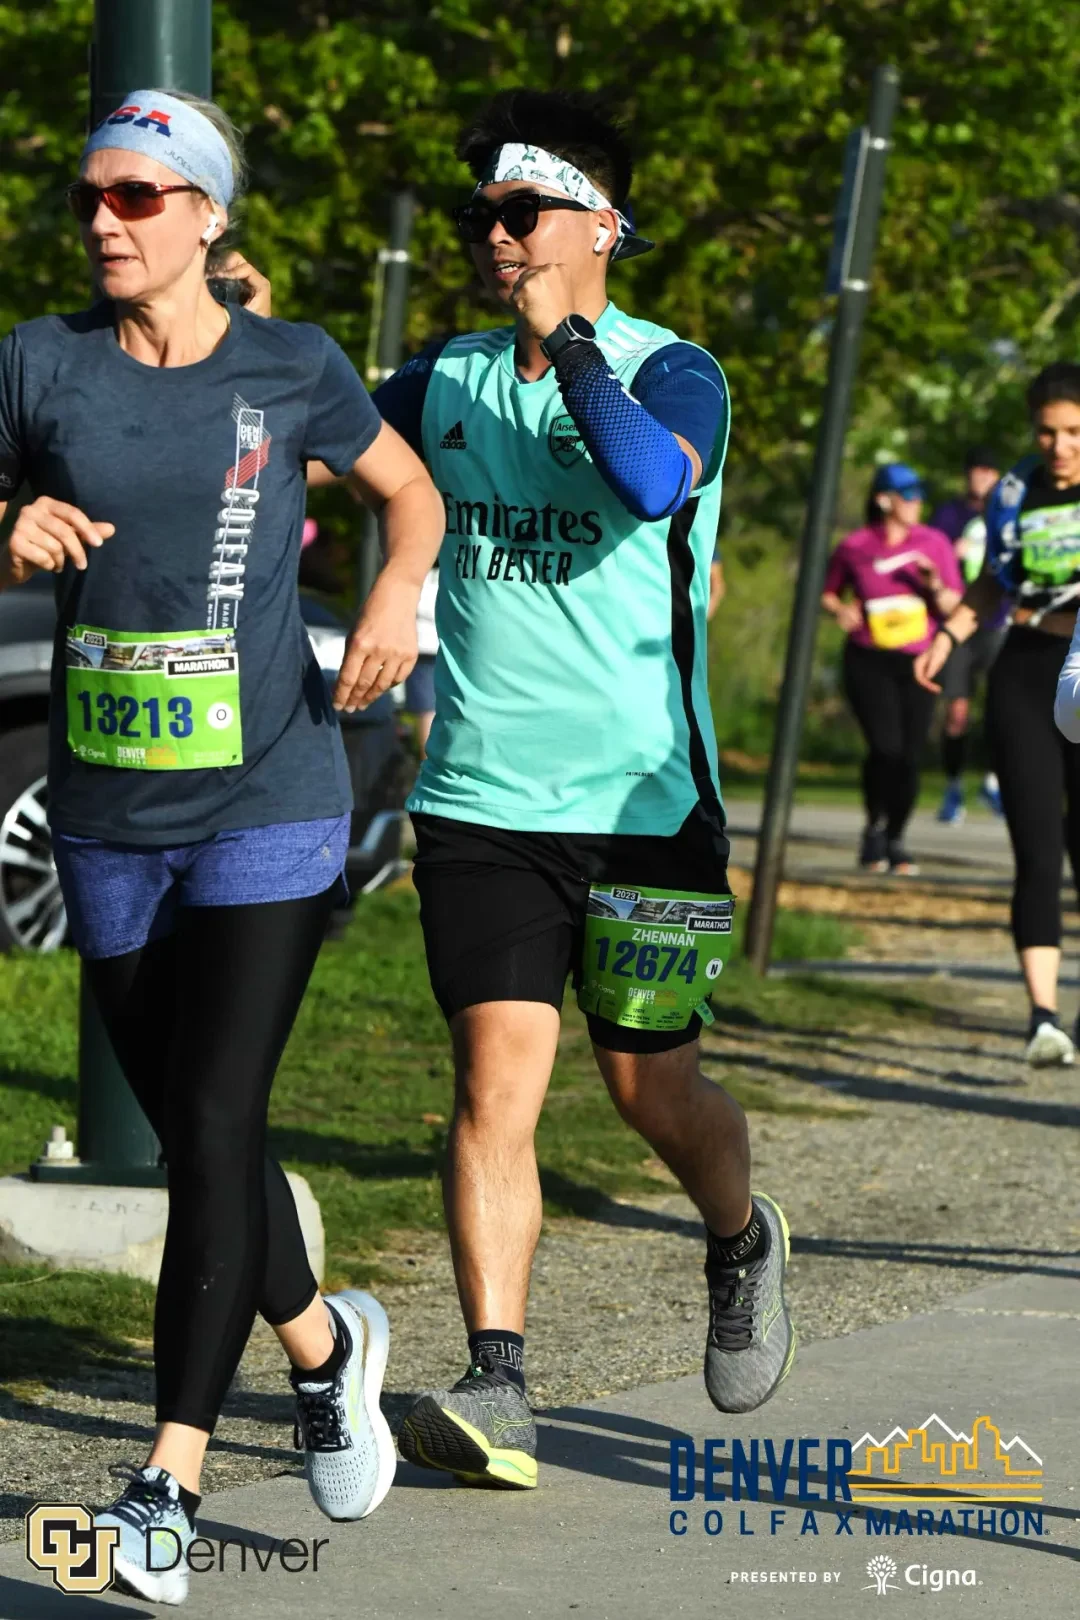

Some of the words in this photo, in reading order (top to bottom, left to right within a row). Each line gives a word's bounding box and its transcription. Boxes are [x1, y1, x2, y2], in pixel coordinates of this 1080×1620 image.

[96, 105, 172, 138] SA
[556, 423, 578, 432] Arsen
[443, 491, 603, 546] Emirates
[206, 487, 260, 601] COLFAX
[455, 544, 482, 580] FLY
[486, 547, 573, 586] BETTER
[222, 602, 230, 628] MARA
[85, 633, 103, 645] 2023
[174, 658, 230, 673] MARATHON
[77, 690, 194, 739] 13213
[117, 746, 146, 759] DENVER
[615, 889, 636, 901] 2023
[693, 919, 730, 930] MARATHON
[631, 927, 696, 947] ZHENNAN
[595, 936, 699, 985] 12674
[710, 964, 718, 976] N
[627, 987, 656, 1001] DENVER
